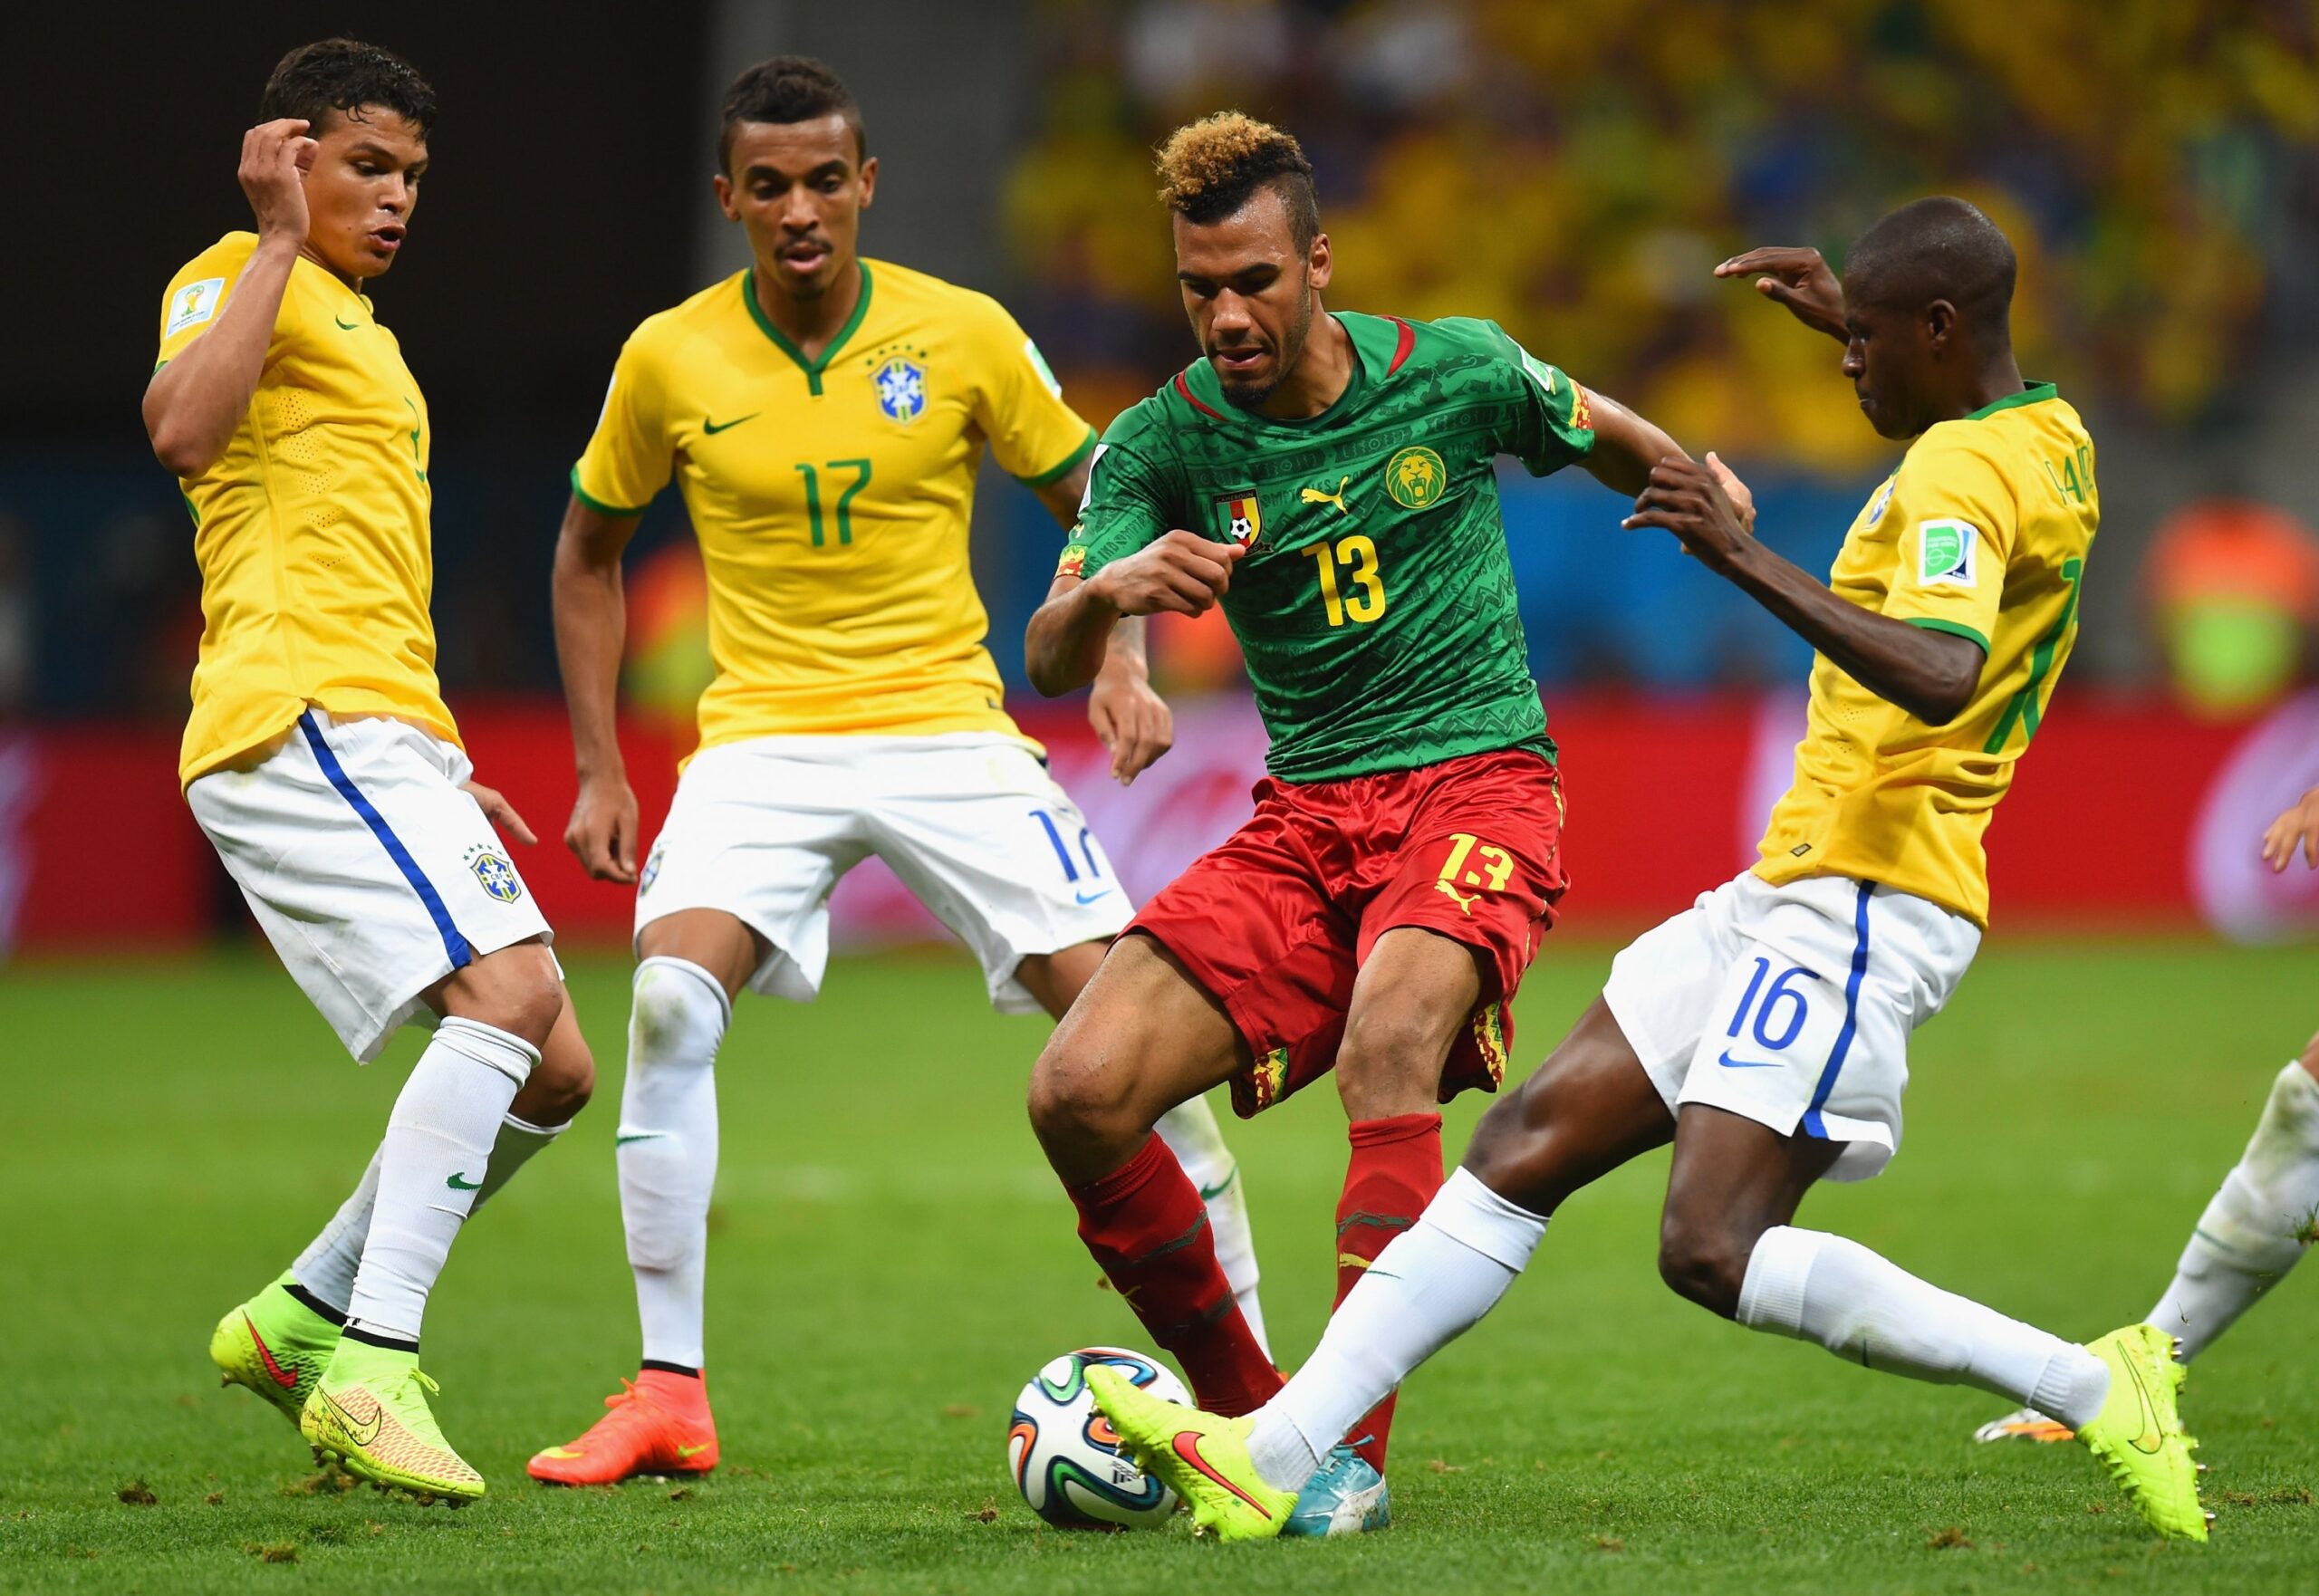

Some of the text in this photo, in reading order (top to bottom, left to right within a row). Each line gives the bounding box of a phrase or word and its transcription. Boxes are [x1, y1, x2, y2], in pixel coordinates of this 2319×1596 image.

[794, 458, 872, 547] 17
[1301, 534, 1386, 627] 13
[1438, 832, 1515, 891] 13
[1727, 957, 1808, 1051] 16
